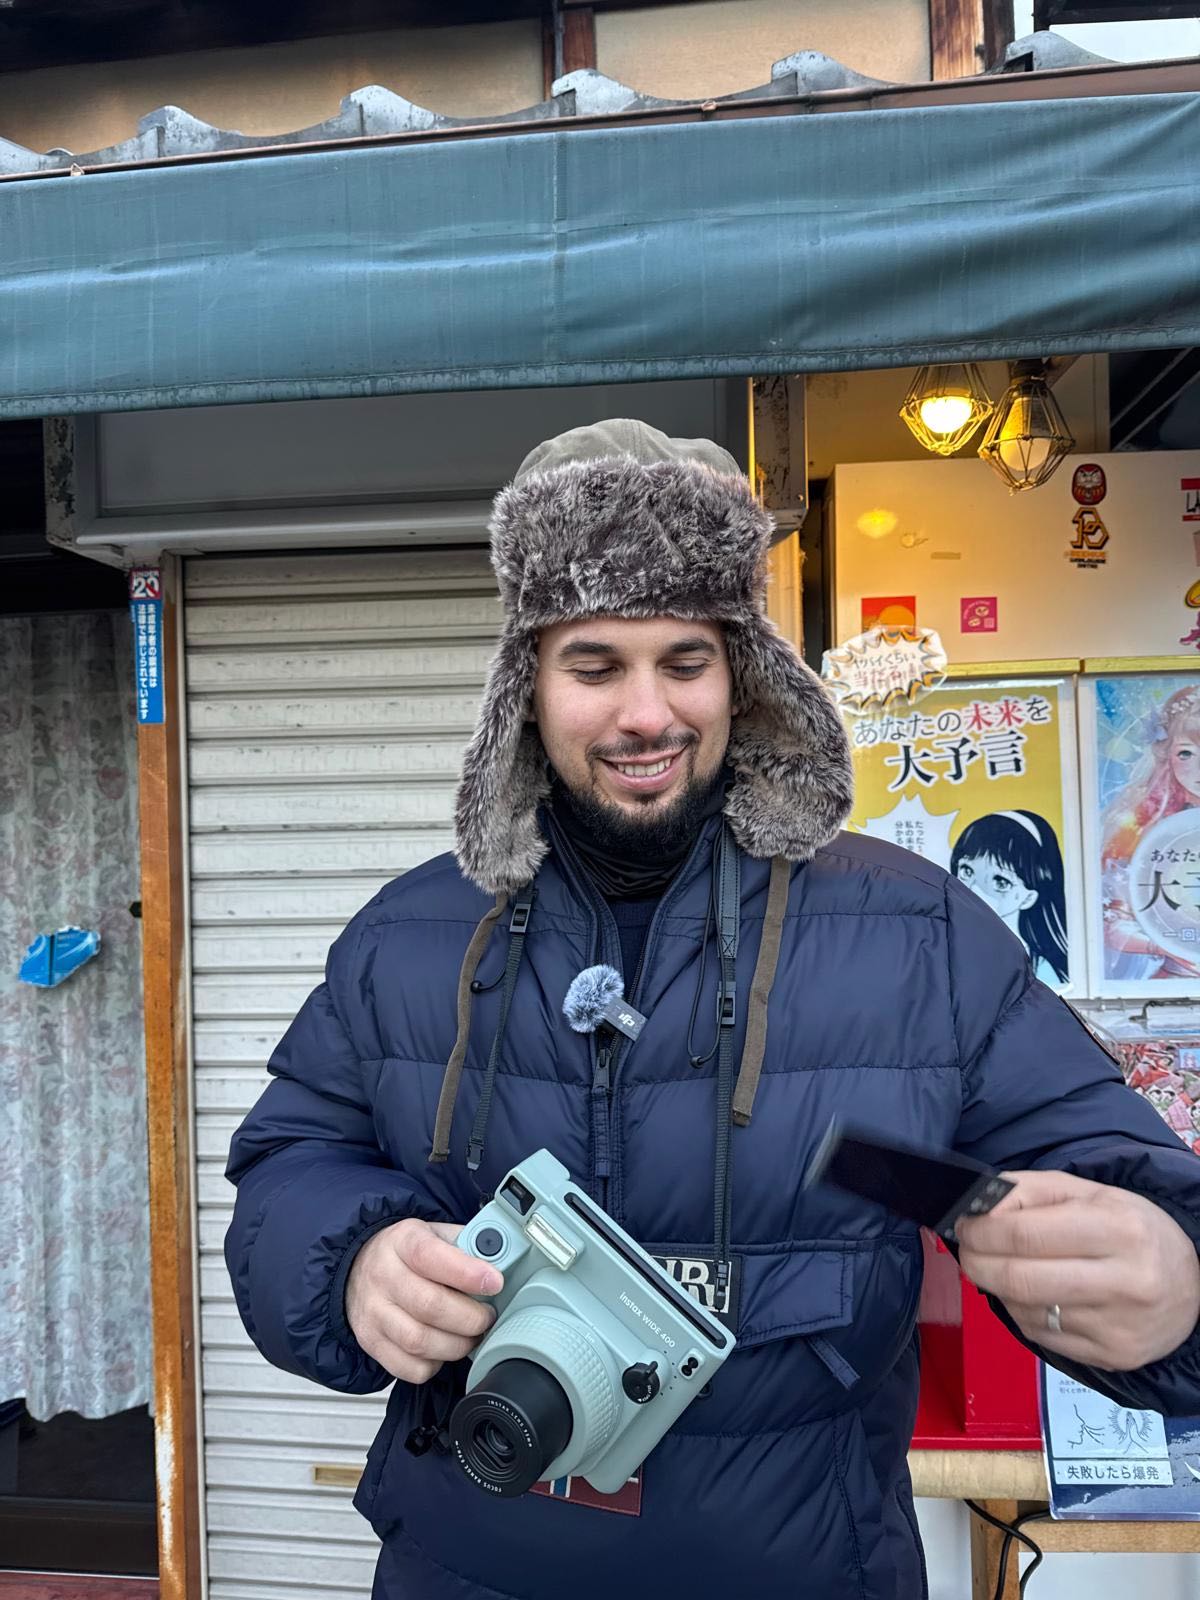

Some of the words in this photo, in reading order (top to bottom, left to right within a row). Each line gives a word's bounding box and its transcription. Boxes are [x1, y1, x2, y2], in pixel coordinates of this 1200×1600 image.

[854, 697, 1049, 745] あなたの未来を
[886, 730, 1025, 790] 大予言
[642, 1313, 662, 1335] WIDE
[660, 1332, 676, 1348] 400
[464, 1464, 482, 1484] RANGE
[1066, 1464, 1160, 1480] 失敗したら爆発
[483, 1481, 502, 1493] FOCUS
